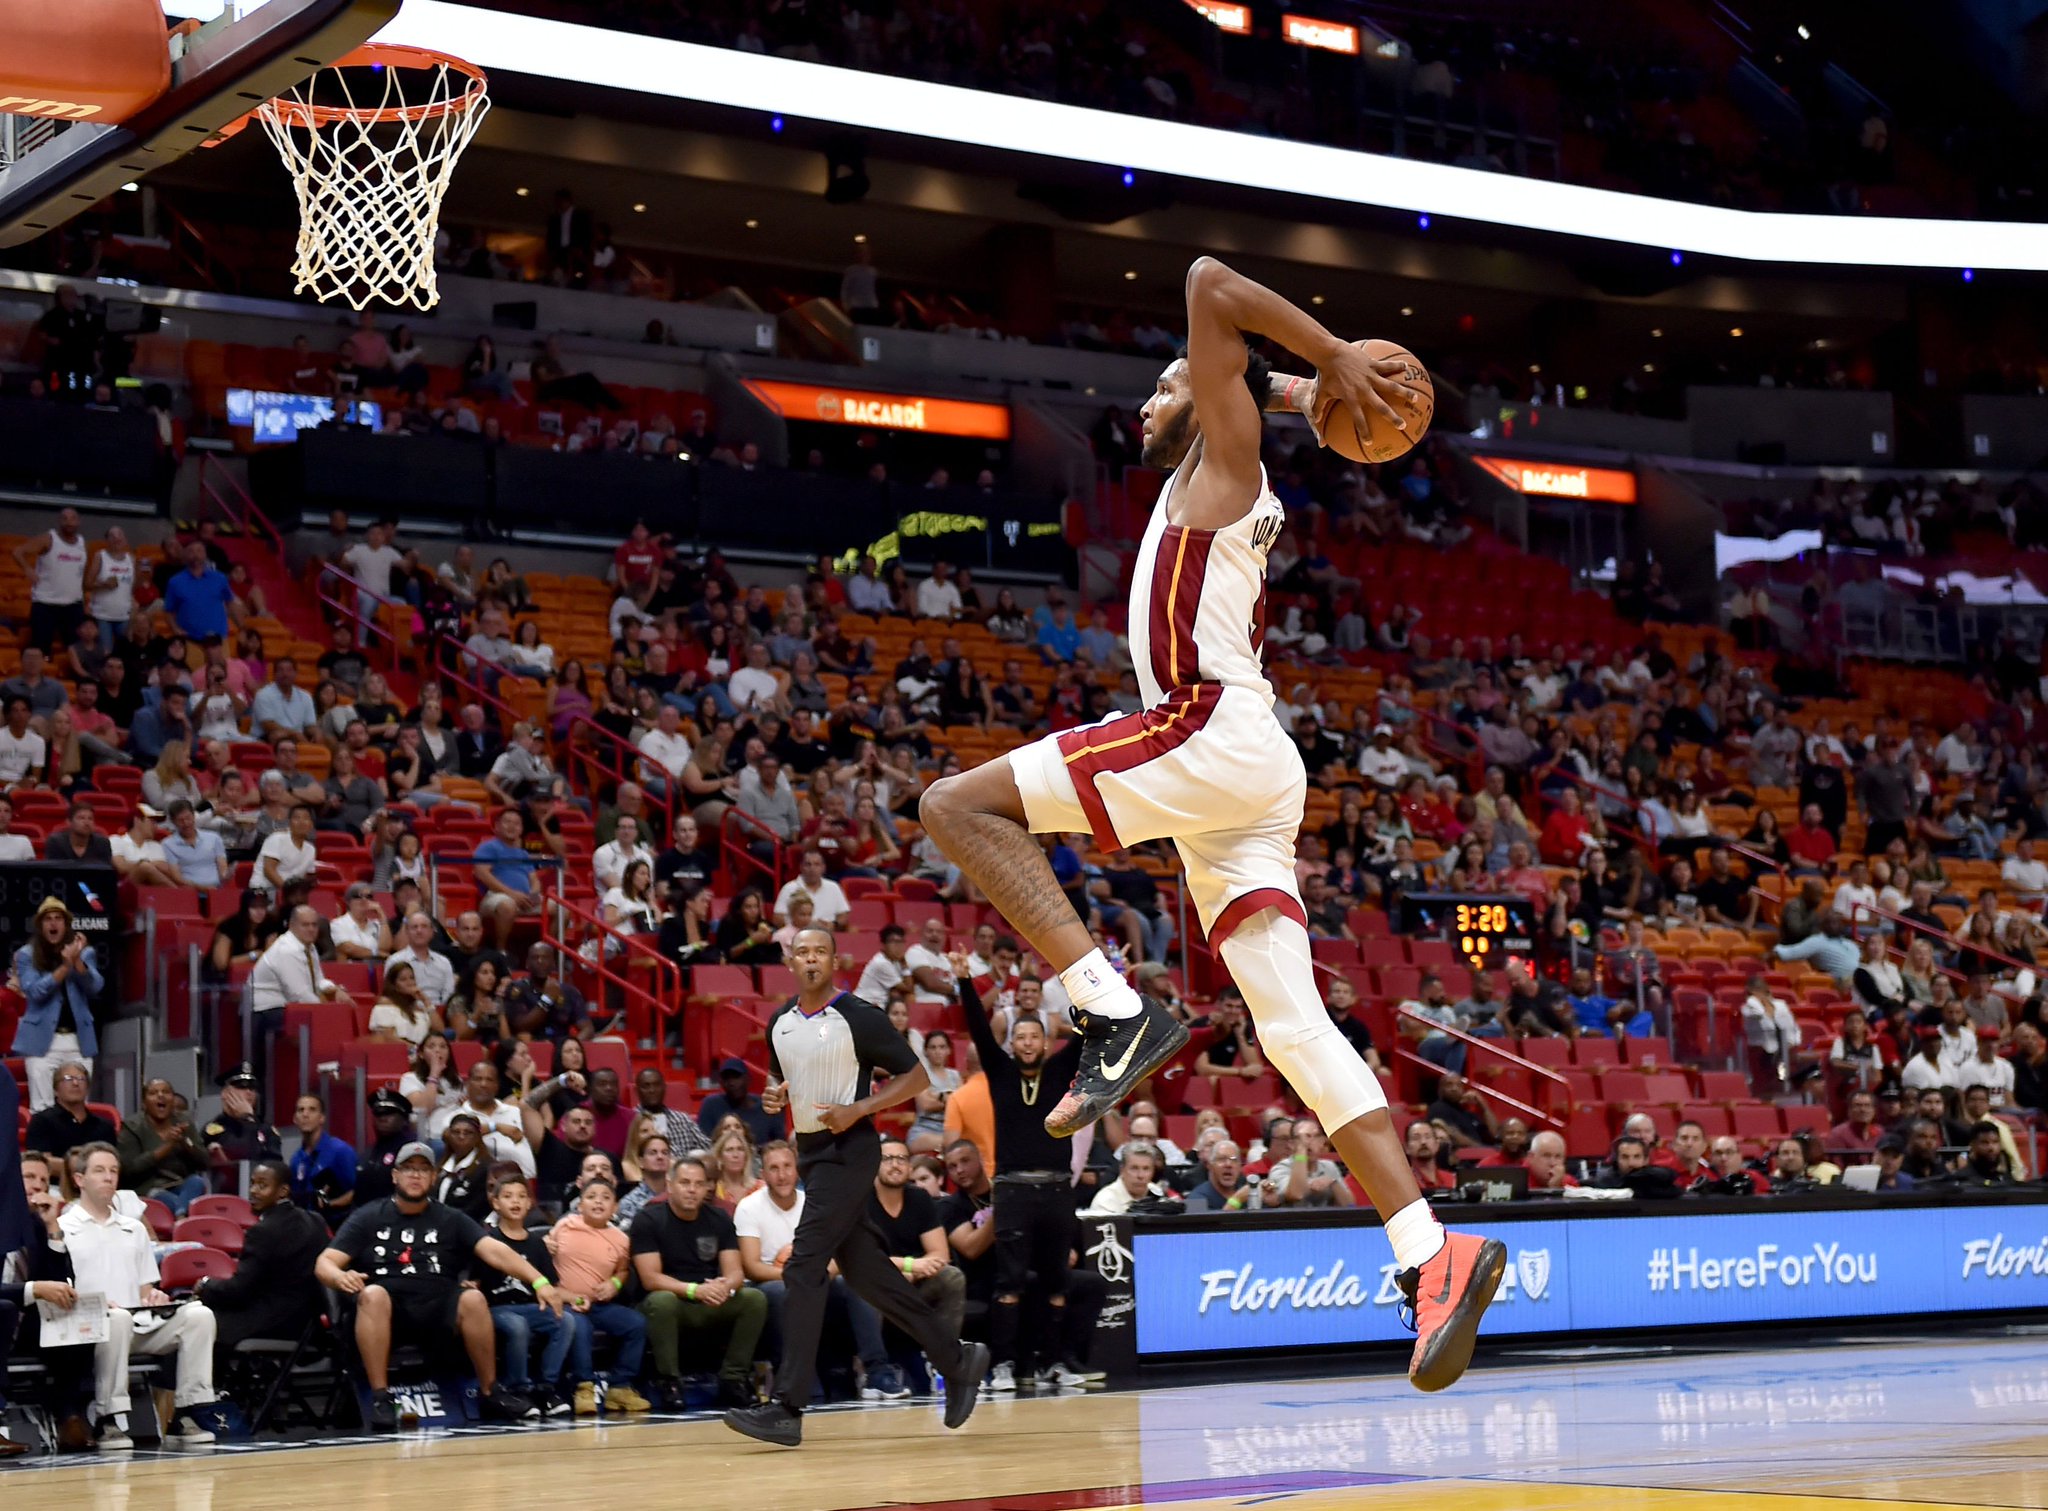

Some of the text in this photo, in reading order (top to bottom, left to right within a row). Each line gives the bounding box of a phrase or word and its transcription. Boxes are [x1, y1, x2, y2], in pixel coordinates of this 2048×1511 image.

[71, 917, 109, 931] ELICANS
[1456, 904, 1507, 933] 3:20
[1647, 1241, 1878, 1291] #HereForYou
[1198, 1258, 1368, 1314] Florida
[394, 1393, 447, 1418] NE
